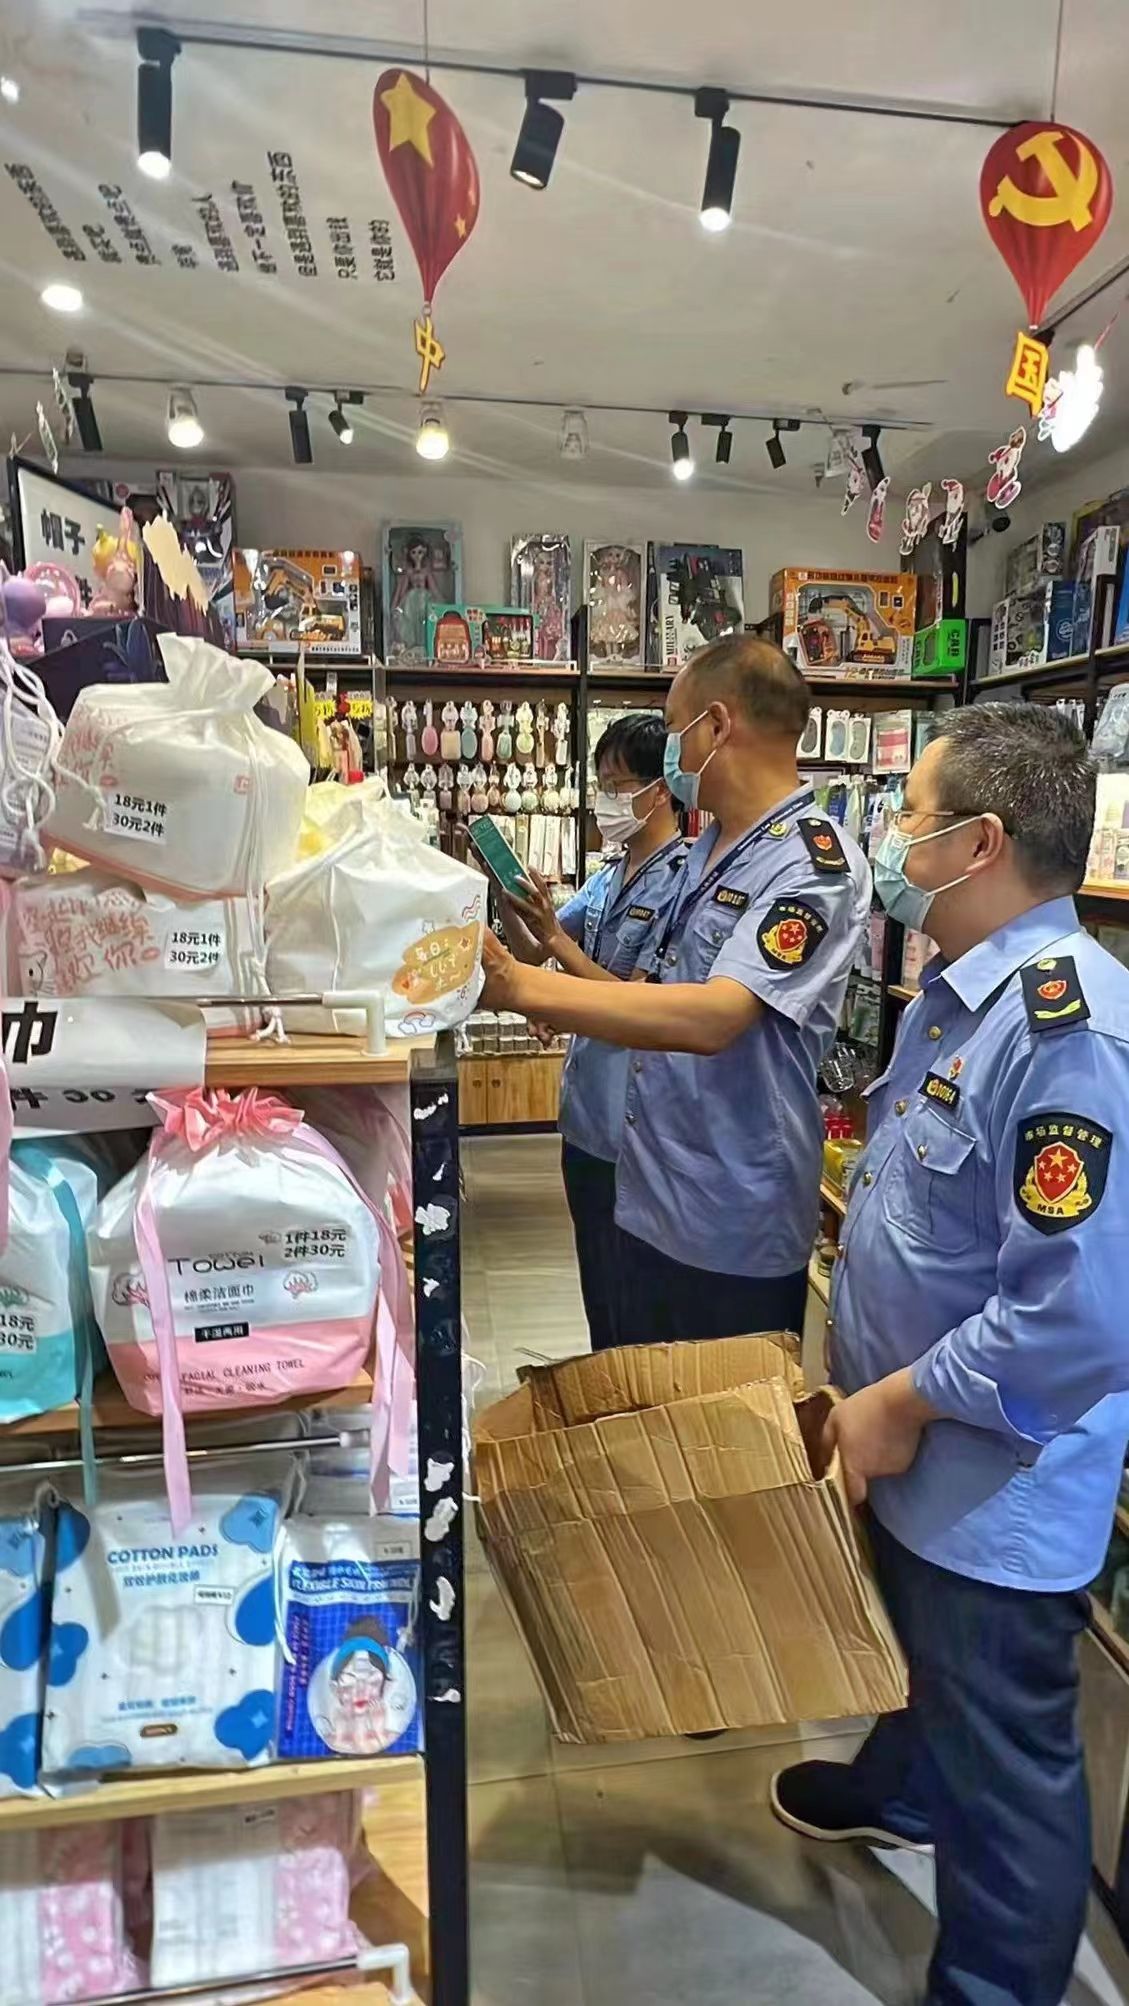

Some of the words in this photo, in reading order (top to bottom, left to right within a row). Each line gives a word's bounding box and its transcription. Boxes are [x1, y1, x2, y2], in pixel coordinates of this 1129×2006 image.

[267, 151, 317, 276] 但是遇到喜欢的东西
[326, 217, 358, 280] 只要你出钱
[368, 219, 395, 281] 它就是你的
[413, 315, 446, 393] 中
[1005, 330, 1048, 419] 国
[41, 508, 85, 556] 帽子
[114, 794, 167, 817] 18元1件
[111, 813, 164, 838] 30元2件
[171, 930, 221, 946] 18元1件
[169, 949, 220, 964] 30元2件
[1, 1001, 58, 1064] 巾
[1024, 1124, 1103, 1149] 市场监督管理
[1037, 1203, 1064, 1216] MSA
[285, 1228, 347, 1245] 1件18元
[284, 1244, 346, 1259] 2件30元
[181, 1369, 216, 1382] FACIAL
[223, 1362, 271, 1378] CLEANING
[276, 1358, 305, 1370] TOWEL
[107, 1546, 174, 1565] COTTON
[178, 1543, 219, 1559] PADS
